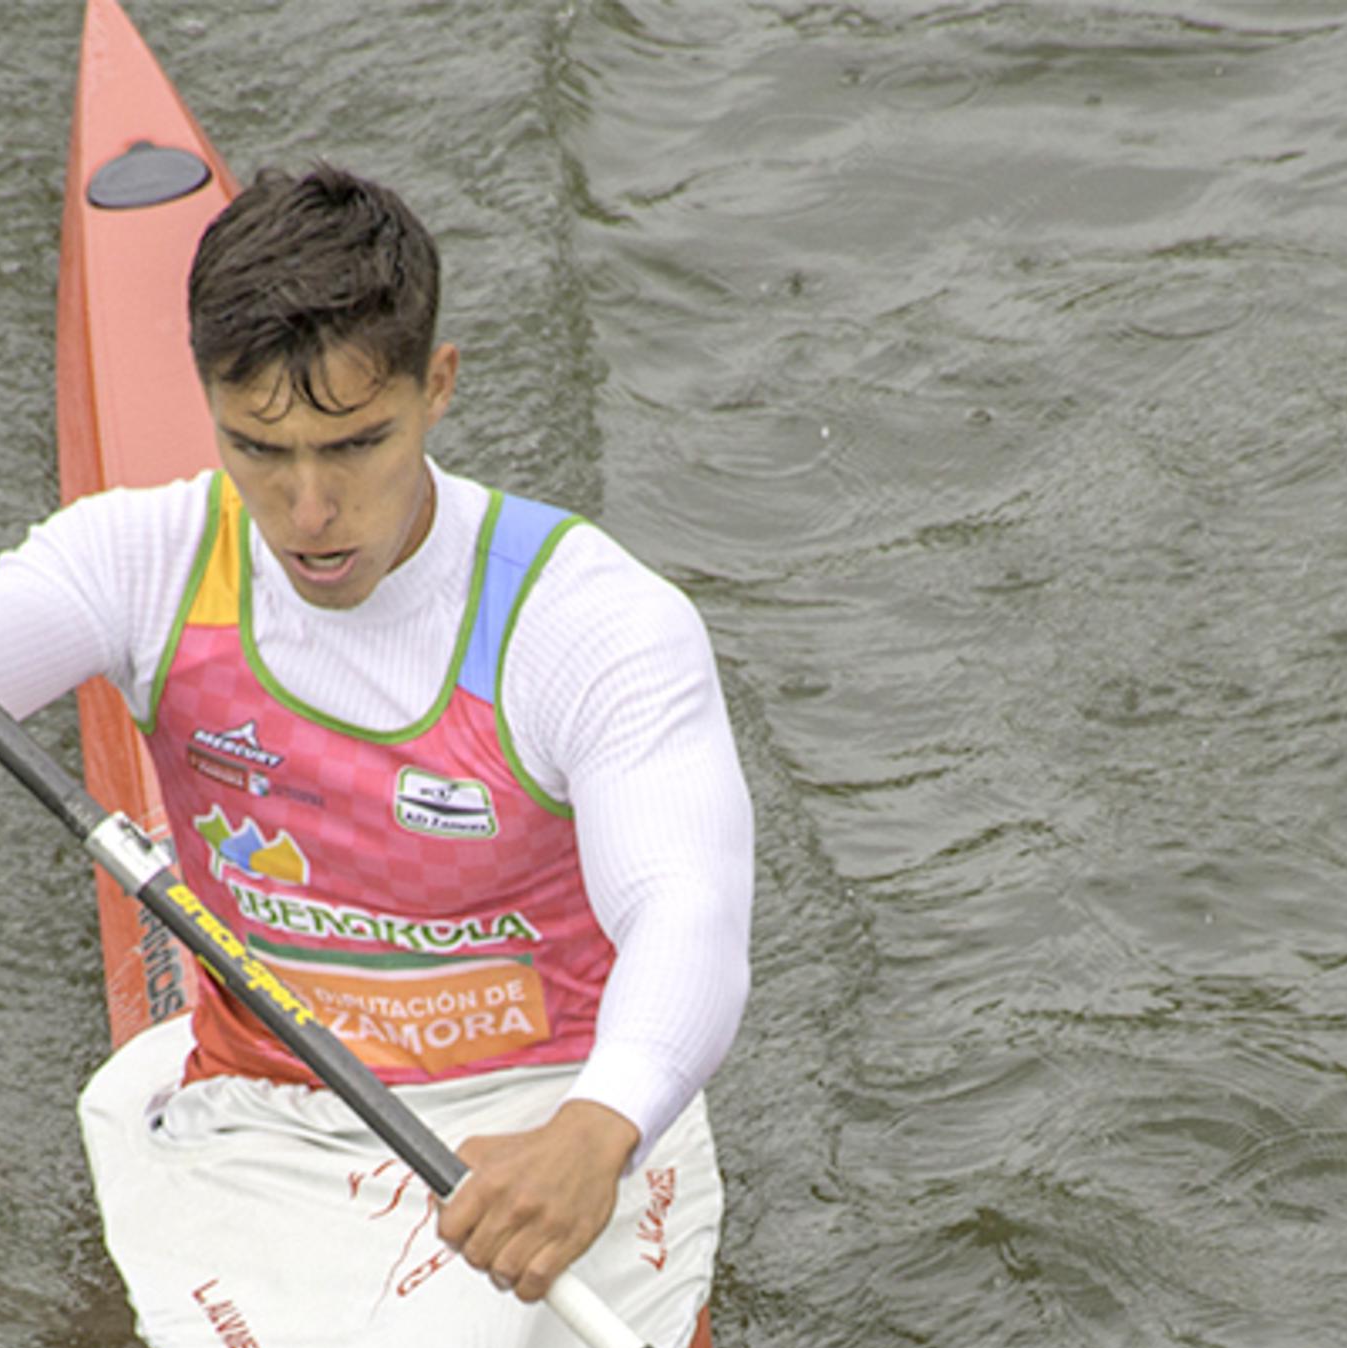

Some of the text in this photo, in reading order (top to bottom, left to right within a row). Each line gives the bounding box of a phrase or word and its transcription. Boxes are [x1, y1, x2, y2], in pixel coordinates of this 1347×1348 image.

[193, 728, 284, 768] MERCURY
[313, 978, 526, 1019] DIPUTACIÓN DE
[326, 1005, 534, 1055] ZAMORA
